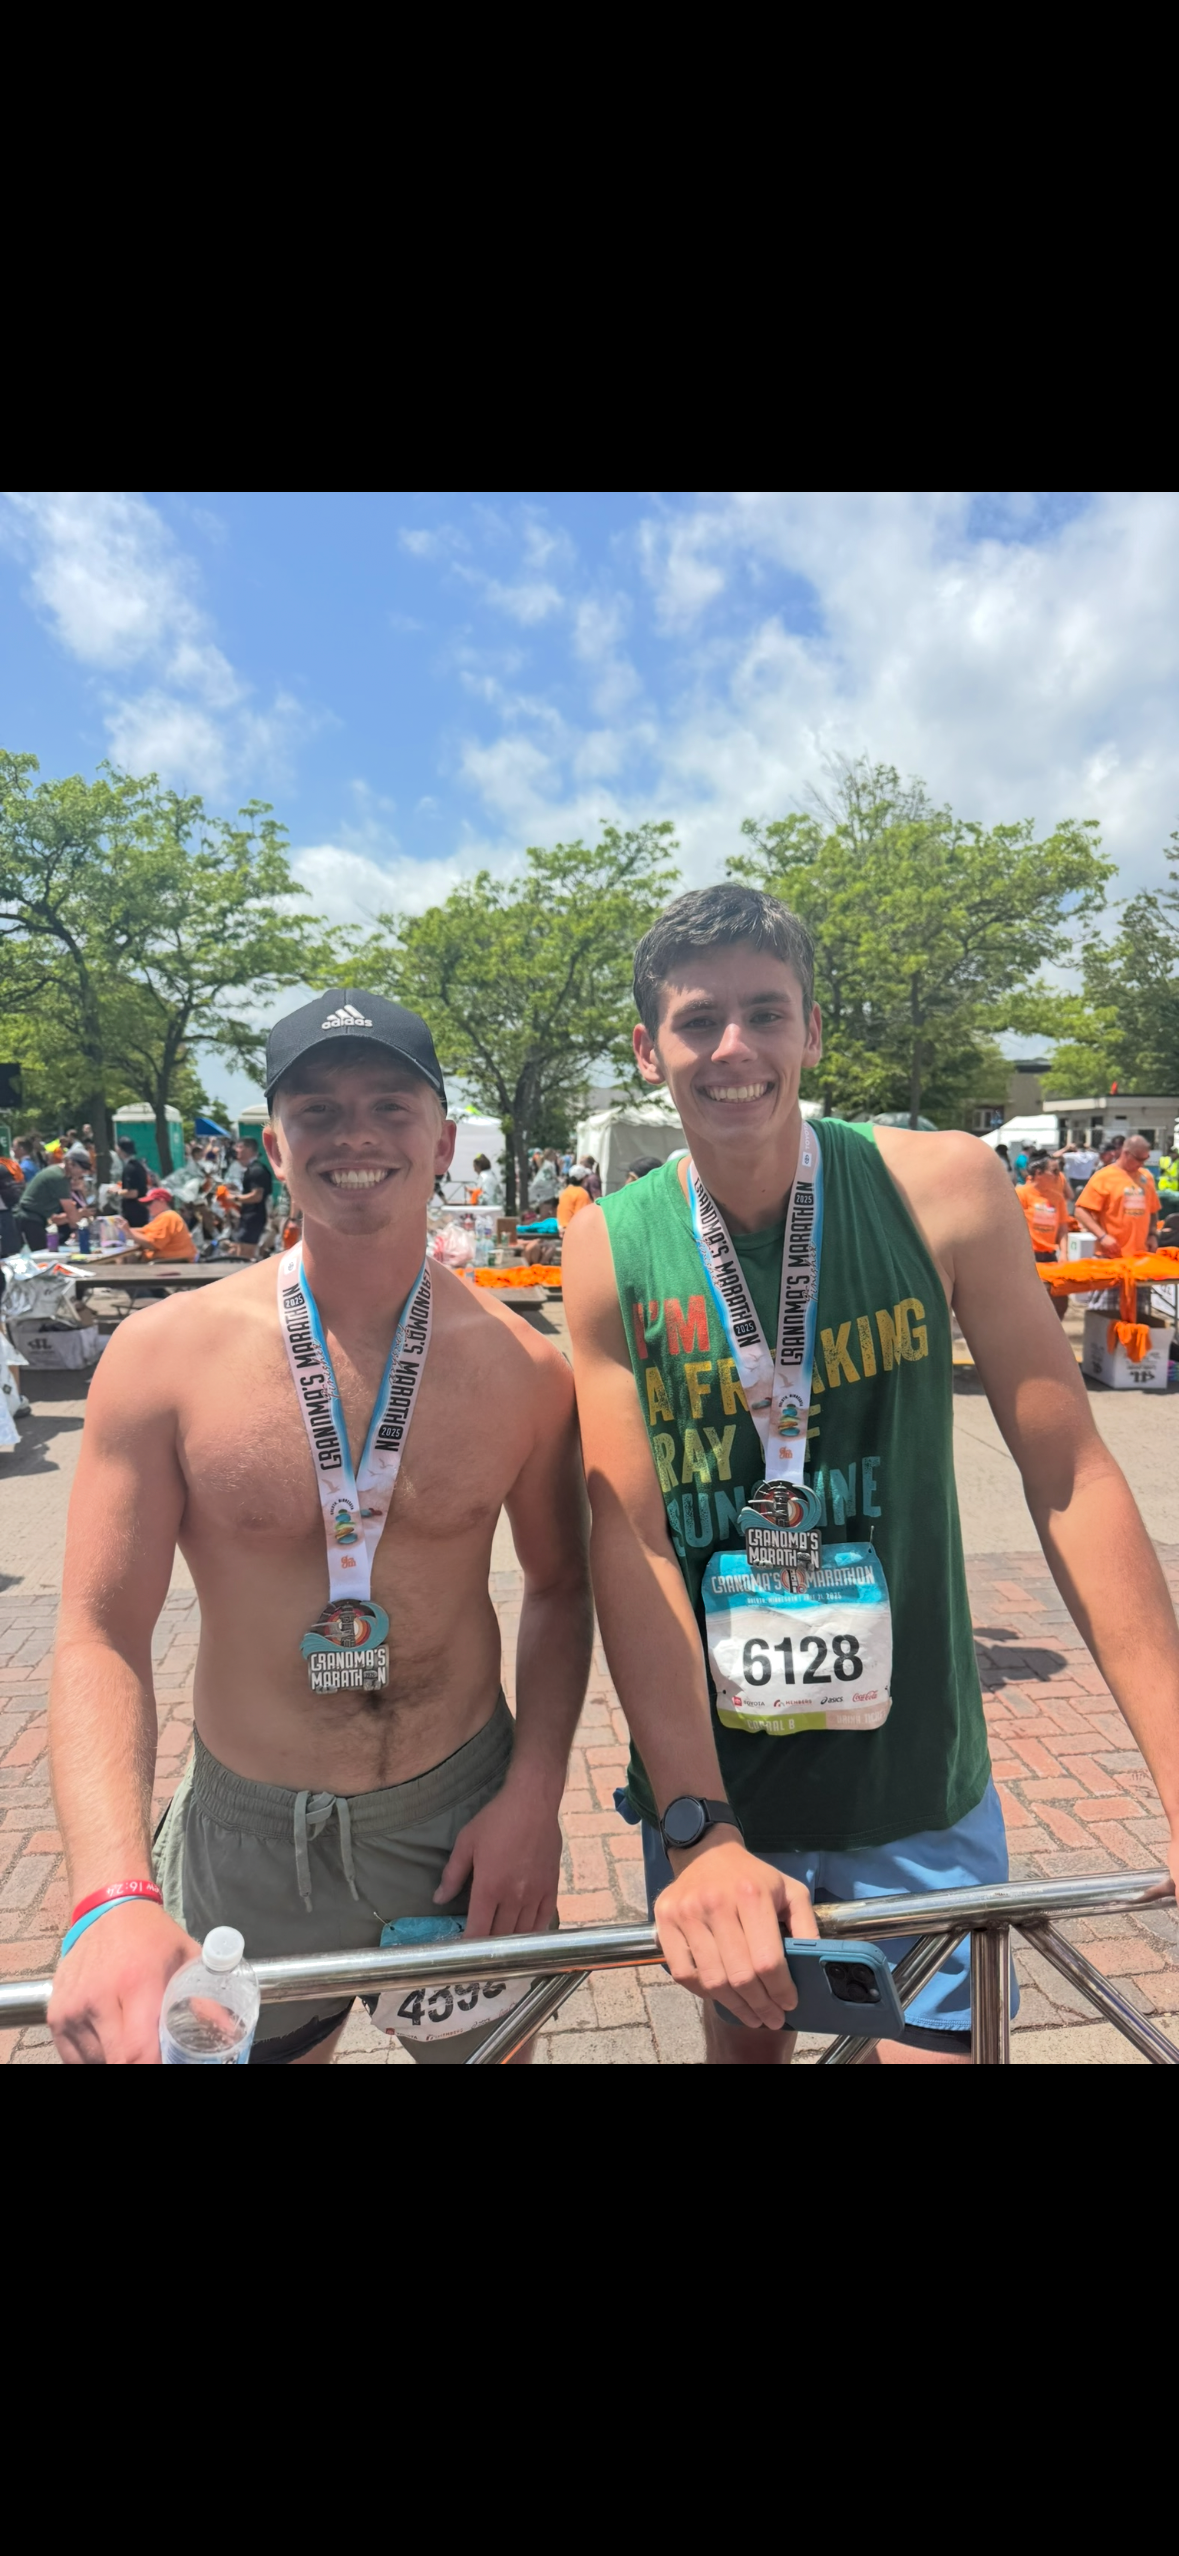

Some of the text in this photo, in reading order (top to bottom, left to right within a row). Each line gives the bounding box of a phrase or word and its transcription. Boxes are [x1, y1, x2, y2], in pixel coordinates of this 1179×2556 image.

[321, 1016, 373, 1030] adidas
[796, 1194, 813, 1204] 2025
[694, 1177, 729, 1259] GRANDMA'S
[285, 1295, 304, 1308] 2025
[402, 1268, 431, 1355] GRANDMA'S
[633, 1295, 710, 1360] I'M
[735, 1321, 755, 1334] 2025
[781, 1275, 810, 1367] GRANDMA'S
[645, 1298, 929, 1426] A FRKING
[300, 1373, 342, 1471] GRANDMA'S
[381, 1426, 401, 1438] 2025
[652, 1424, 737, 1493] RAY
[748, 1528, 819, 1551] GRANDMA'S
[711, 1565, 876, 1594] GRANDMA'S MARATHON
[311, 1648, 386, 1672] GRANDMA'S
[742, 1634, 864, 1687] 6128
[788, 1719, 796, 1730] B
[106, 1881, 143, 1897] 16:24
